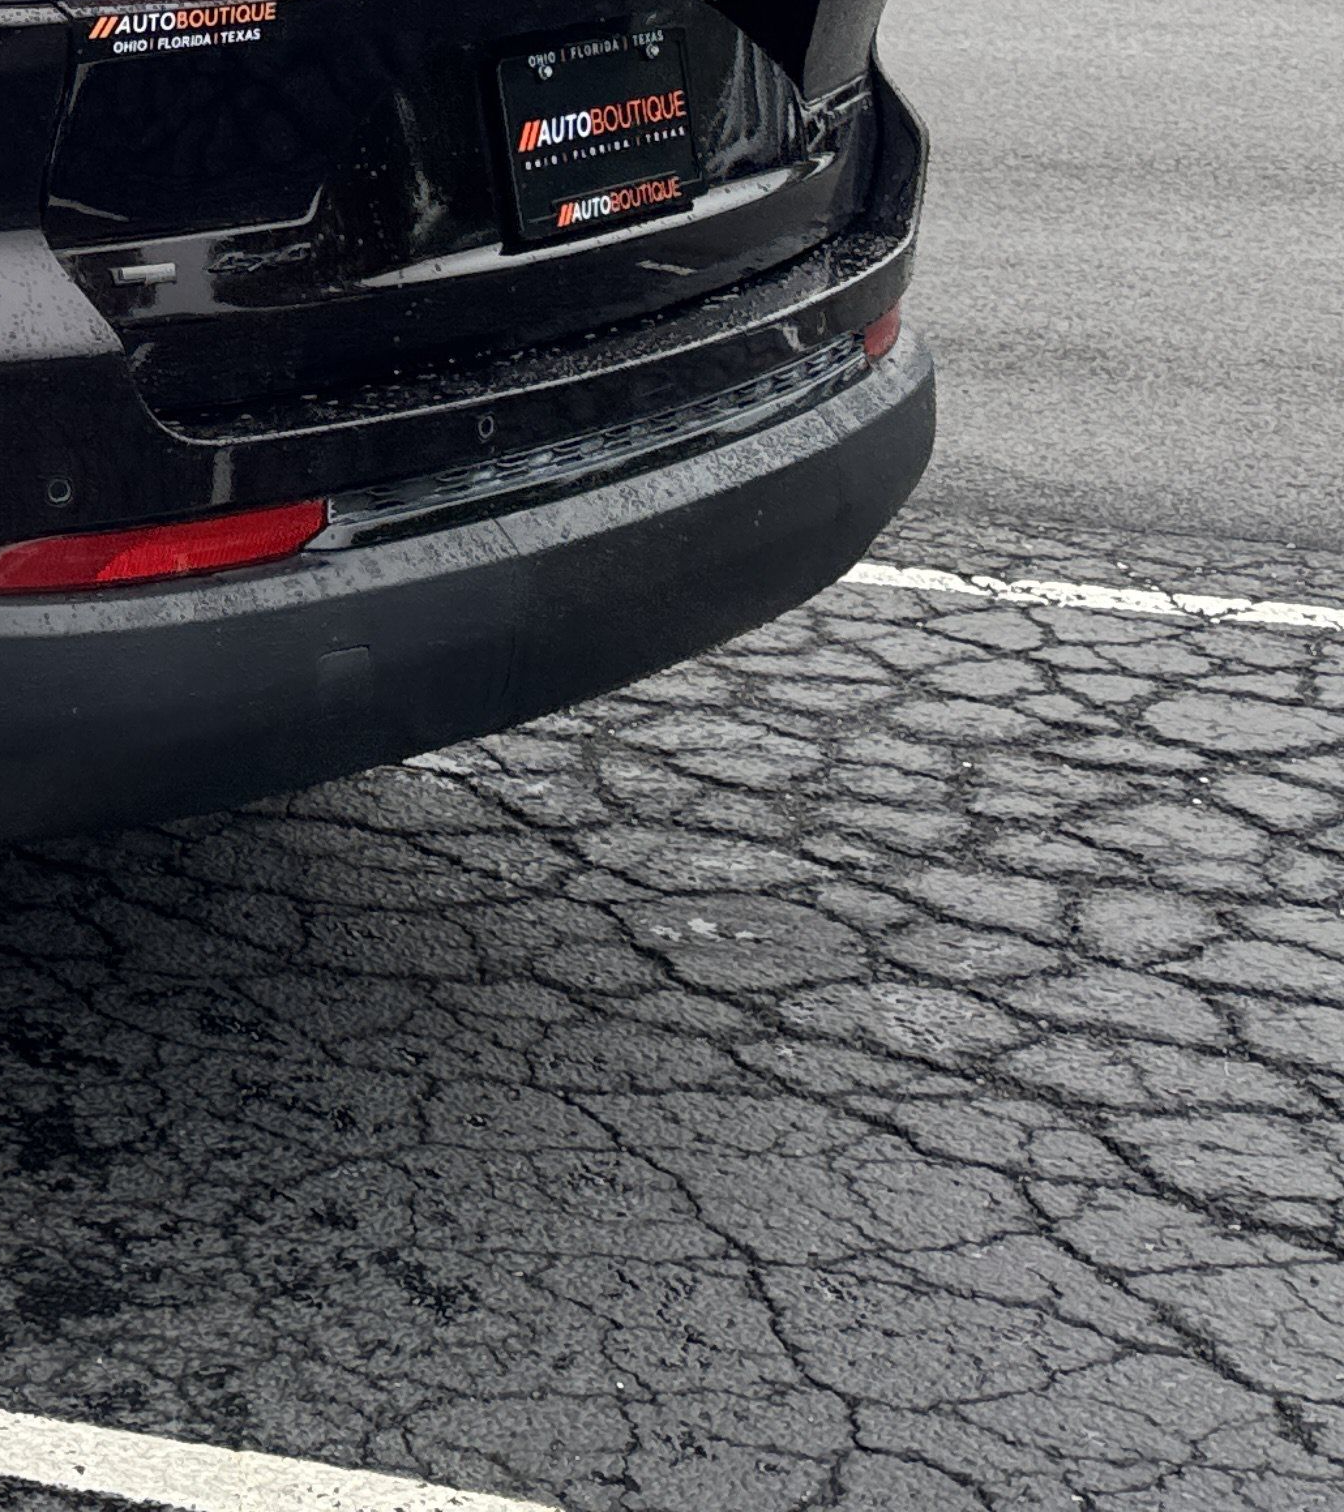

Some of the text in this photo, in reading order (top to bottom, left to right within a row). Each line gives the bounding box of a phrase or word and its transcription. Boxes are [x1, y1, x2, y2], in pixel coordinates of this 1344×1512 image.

[115, 2, 277, 34] AUTOBOUTIQUE
[113, 29, 261, 54] OHIO FLORIDA TEXAS
[528, 30, 664, 67] OHIO FLORIDA TEXAS
[537, 90, 687, 147] AUTOBOUTIQUE
